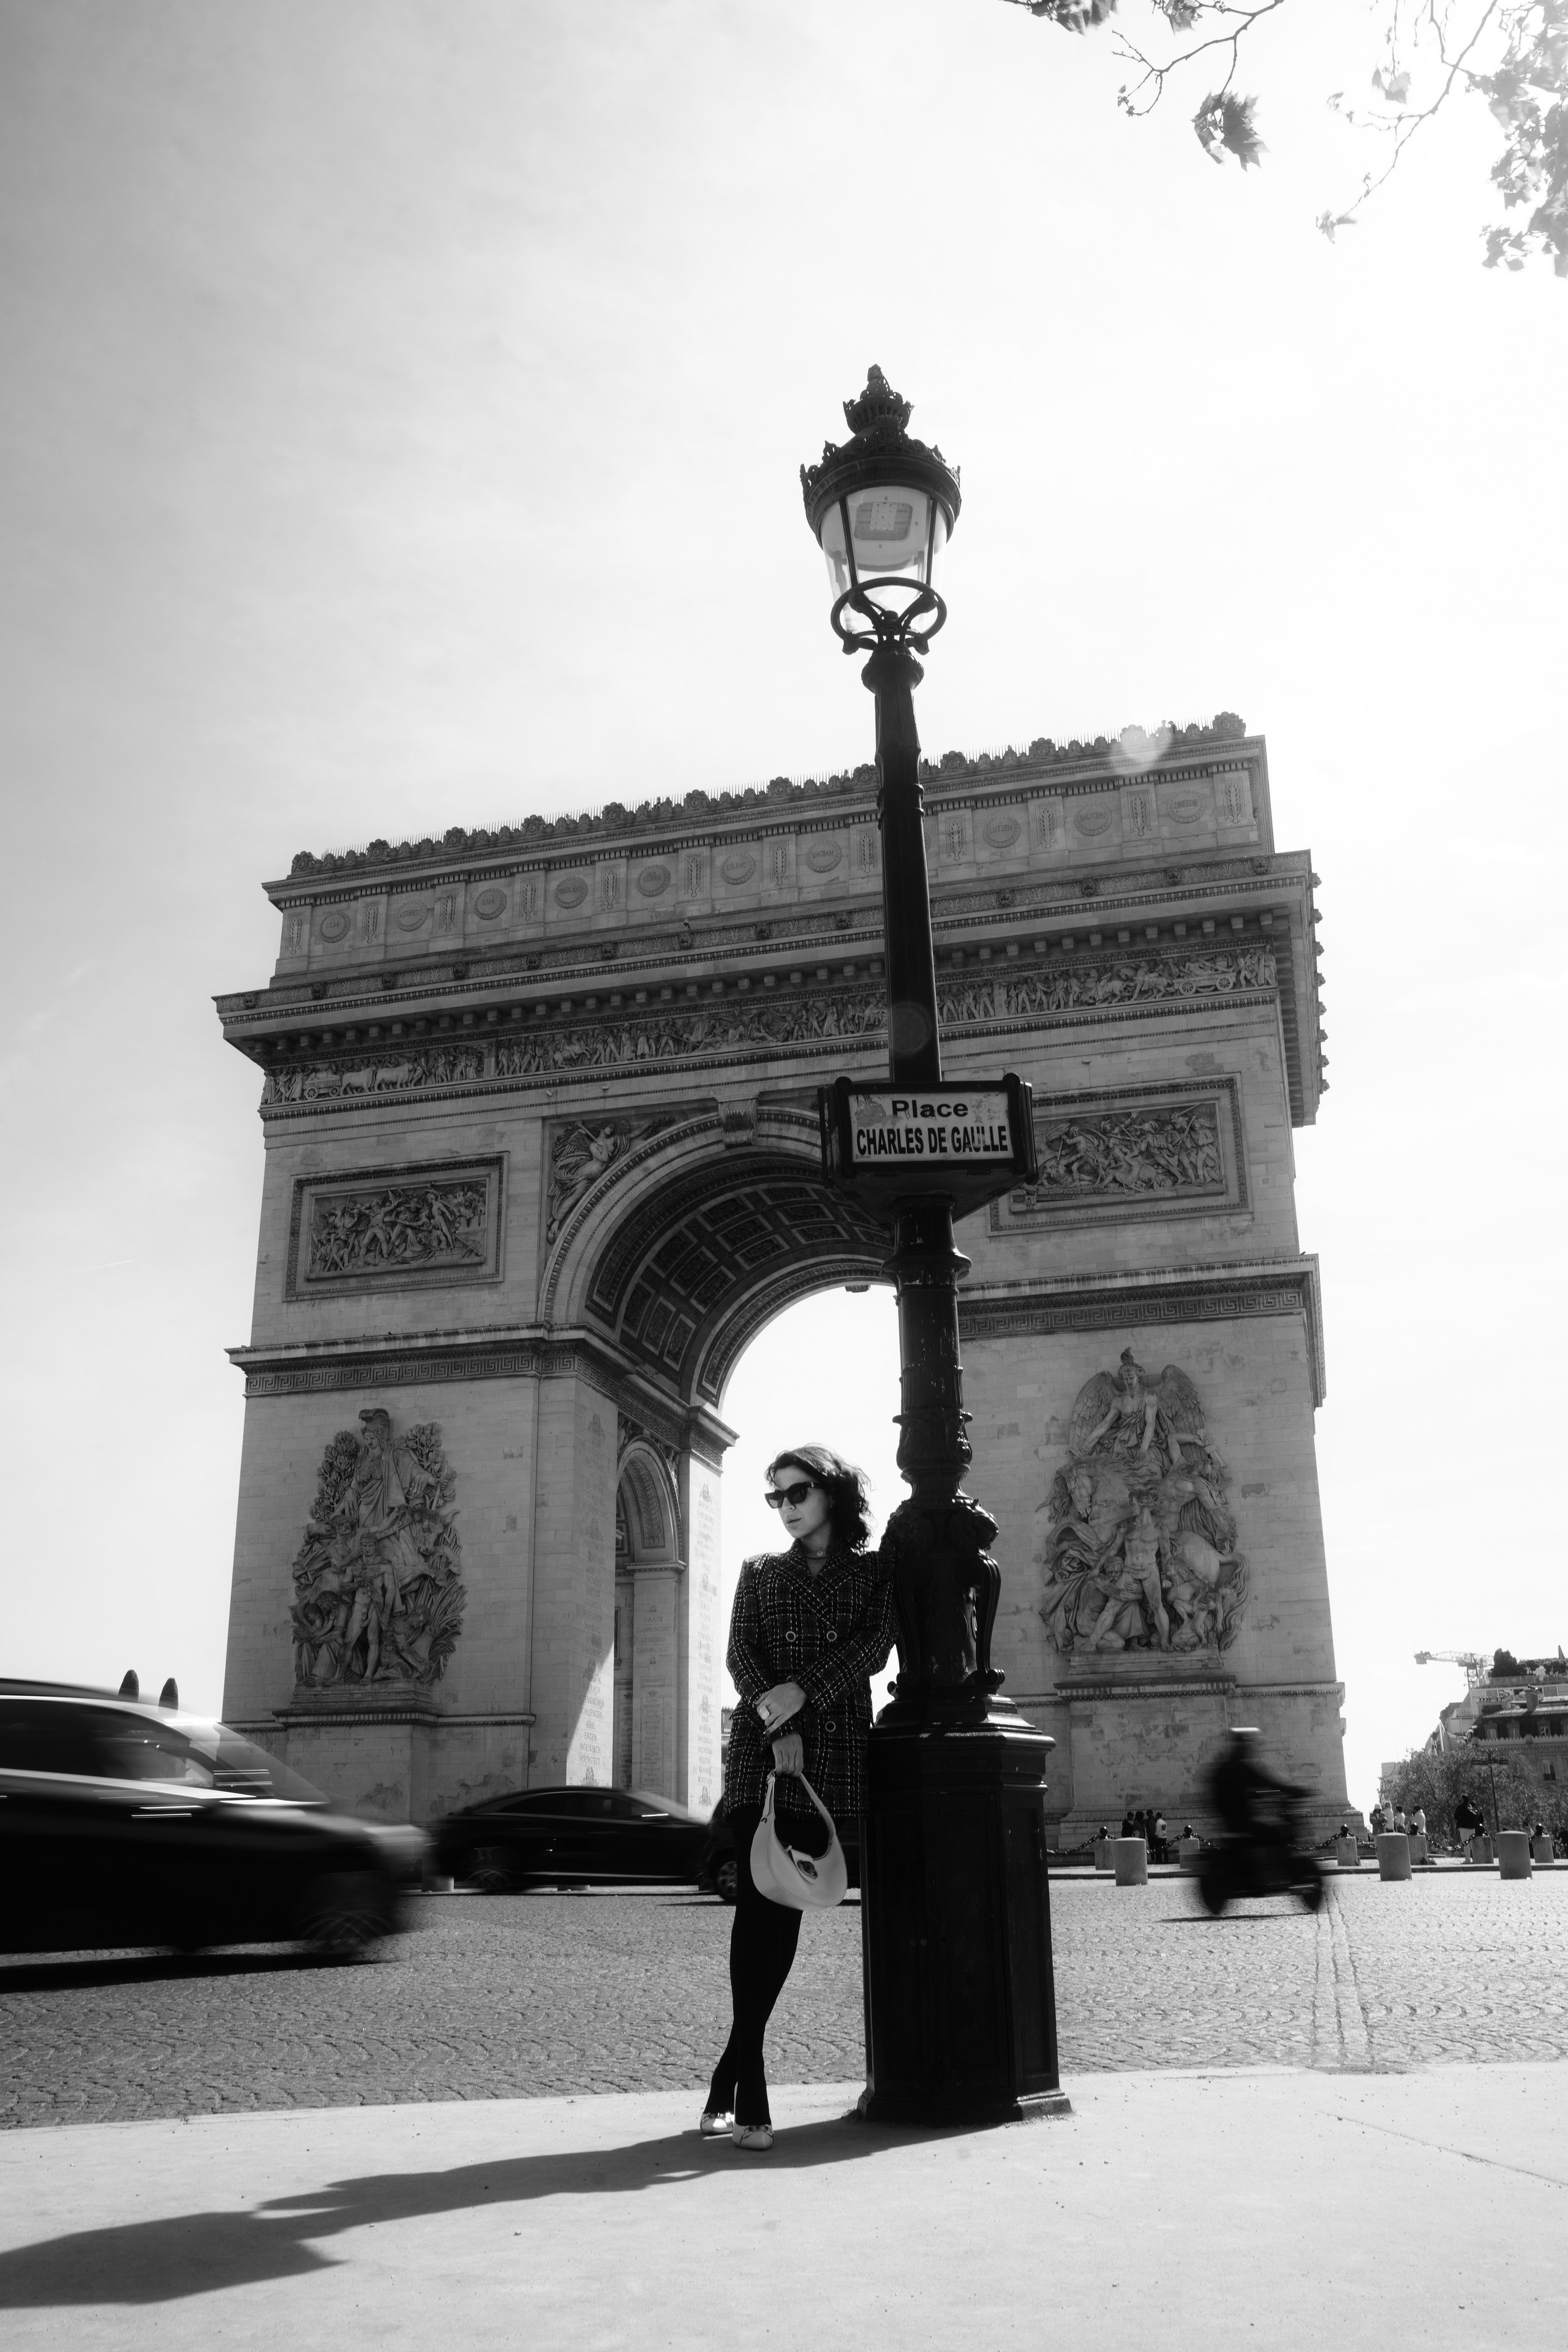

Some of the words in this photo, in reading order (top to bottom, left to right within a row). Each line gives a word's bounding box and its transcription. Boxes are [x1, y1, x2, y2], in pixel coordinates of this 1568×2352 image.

[1174, 799, 1199, 809] DRESDE
[1080, 812, 1106, 822] BAUTZEN
[989, 824, 1013, 834] LUTZEN
[811, 850, 834, 859] WAGRAM
[643, 874, 662, 883] SIERRA
[558, 886, 581, 895] FRIEDLAND
[481, 898, 495, 907] IENA
[892, 1099, 968, 1118] Place
[858, 1128, 924, 1156] CHARLES
[927, 1127, 948, 1154] DE
[951, 1125, 1008, 1153] GAULLE
[584, 1732, 597, 1741] ENGEN
[580, 1743, 601, 1754] MOESKIRCH
